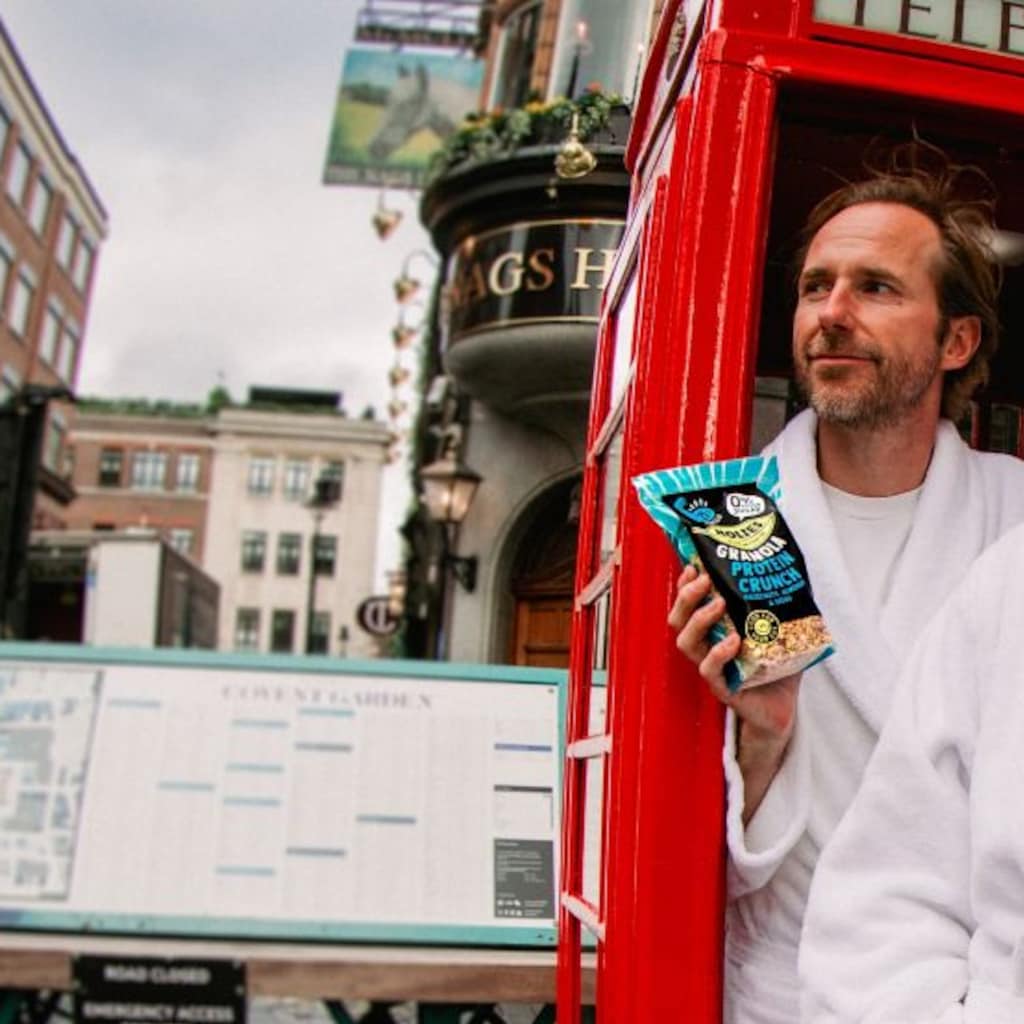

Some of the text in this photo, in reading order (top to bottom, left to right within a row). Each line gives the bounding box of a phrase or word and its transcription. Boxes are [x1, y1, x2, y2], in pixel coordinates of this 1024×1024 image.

[716, 536, 787, 561] GRANOLA
[731, 550, 795, 577] PROTEIN
[738, 567, 802, 593] CRUNCH
